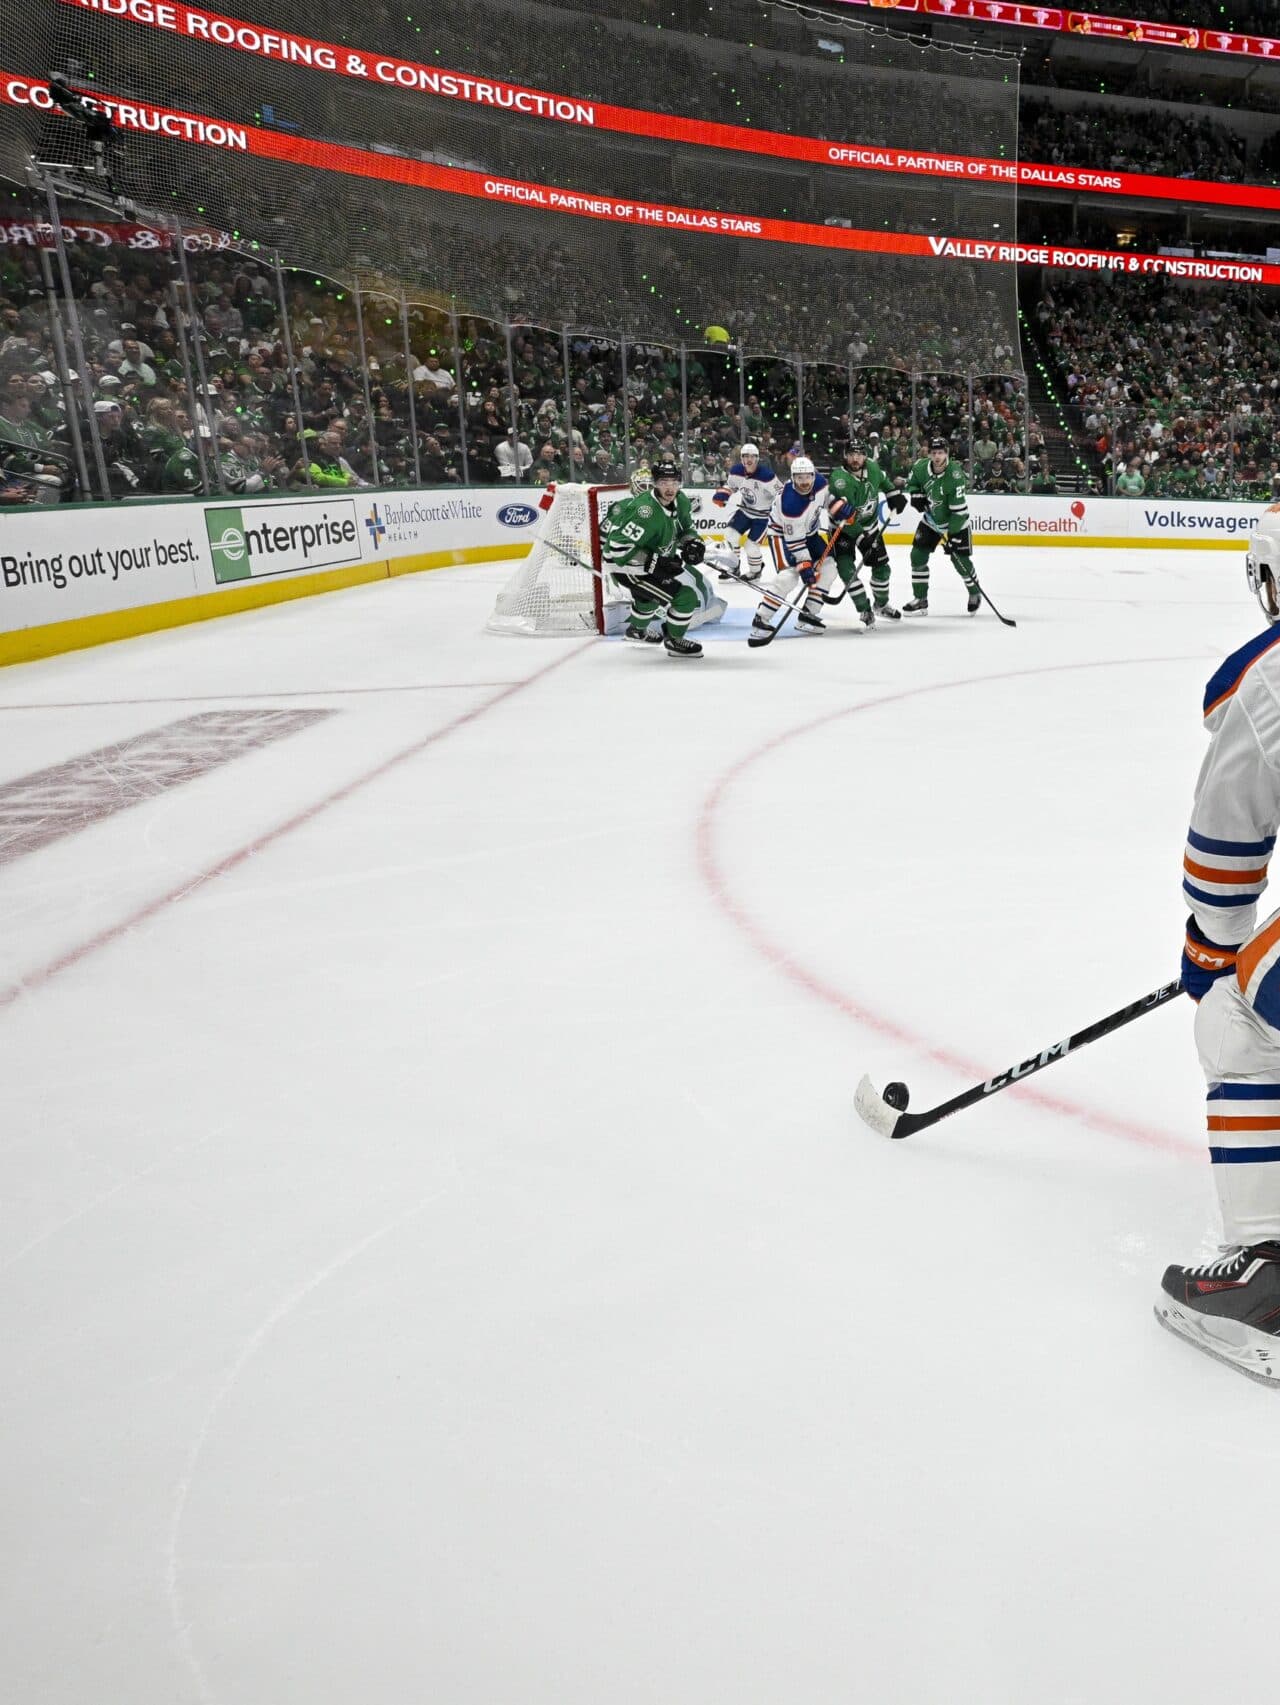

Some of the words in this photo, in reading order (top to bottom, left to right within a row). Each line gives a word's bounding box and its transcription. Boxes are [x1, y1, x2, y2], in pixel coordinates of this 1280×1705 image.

[186, 14, 336, 69] ROOFING
[346, 54, 368, 77] &
[376, 62, 594, 124] CONSTRUCTION
[7, 81, 247, 149] COTRUCTION
[828, 147, 894, 166] OFFICIAL
[897, 155, 964, 173] PARTNER
[967, 163, 987, 175] OF
[990, 165, 1017, 178] THE
[1021, 168, 1075, 184] DALLAS
[1078, 174, 1121, 189] STARS
[484, 181, 547, 204] OFFICIAL
[550, 193, 611, 215] PARTNER
[615, 204, 633, 217] OF
[636, 207, 663, 222] THE
[666, 211, 718, 228] DALLAS
[721, 218, 761, 233] STARS
[928, 237, 996, 259] VALLEY
[999, 247, 1048, 264] RIDGE
[1053, 251, 1125, 271] ROOFING
[1128, 258, 1140, 271] &
[183, 468, 194, 480] 4
[388, 531, 418, 541] HEALTH
[504, 507, 531, 524] Ford
[621, 521, 645, 542] 53
[1145, 511, 1259, 533] Volkswagen
[212, 513, 356, 561] enterprise
[1, 552, 67, 589] Bring
[69, 547, 106, 578] out
[108, 545, 151, 580] your
[154, 538, 199, 566] best.
[983, 1036, 1072, 1093] CCM
